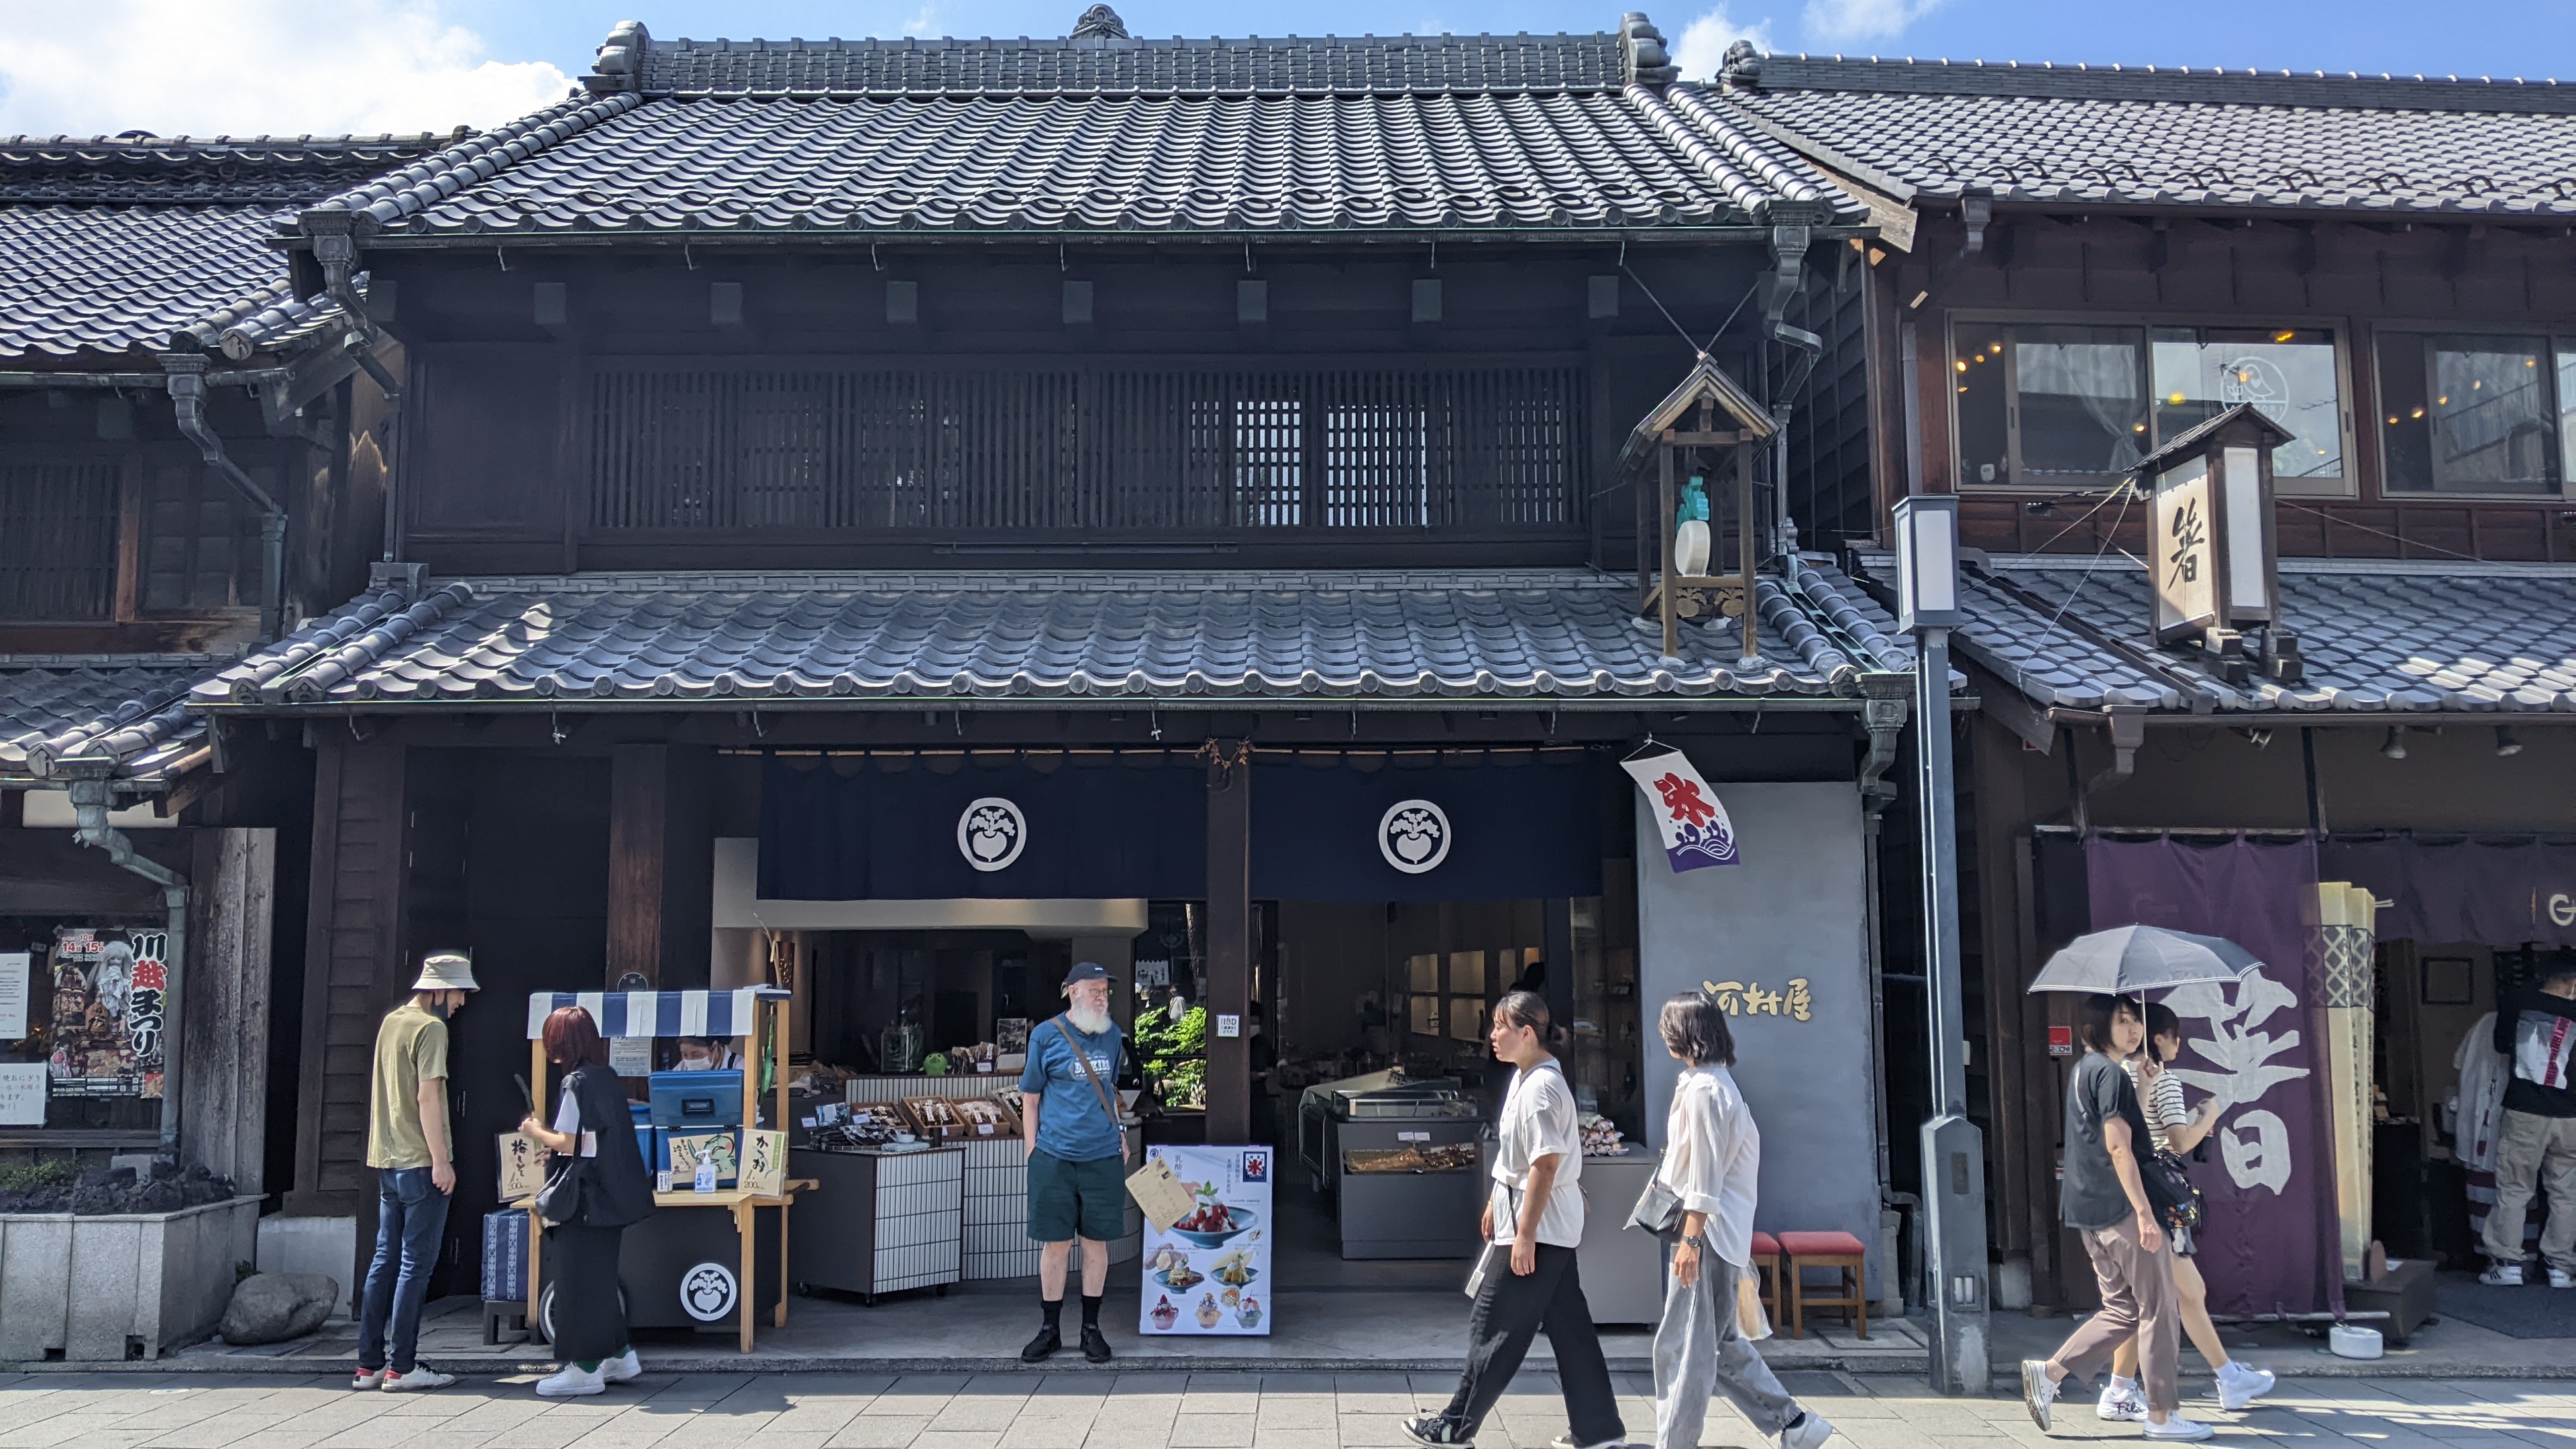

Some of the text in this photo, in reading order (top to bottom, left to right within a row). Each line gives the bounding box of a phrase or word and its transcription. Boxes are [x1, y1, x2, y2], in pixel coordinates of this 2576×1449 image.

[2167, 497, 2205, 592] 箸
[1654, 772, 1715, 828] 氷
[128, 933, 168, 1057] 川越まつり
[511, 1138, 528, 1177] 梅しそ
[752, 1135, 769, 1173] かつお
